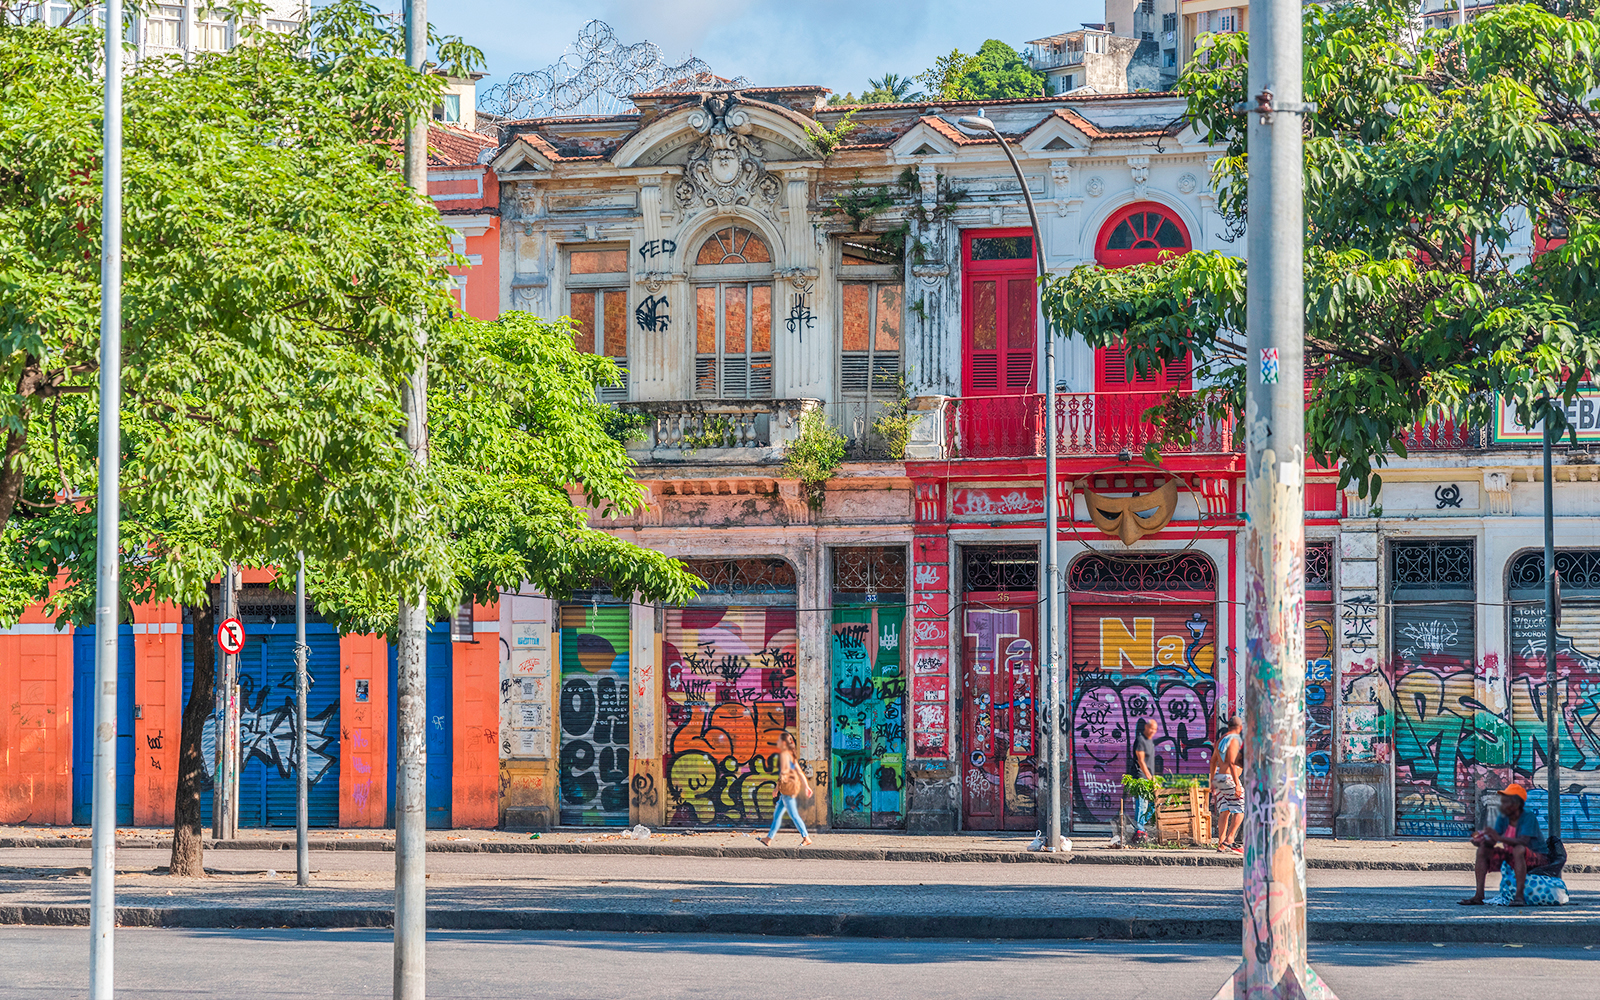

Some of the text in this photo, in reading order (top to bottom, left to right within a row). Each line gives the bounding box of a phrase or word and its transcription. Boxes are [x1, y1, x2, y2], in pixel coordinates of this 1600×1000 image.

[997, 593, 1010, 602] 35
[228, 626, 237, 646] E
[1099, 617, 1188, 670] Na
